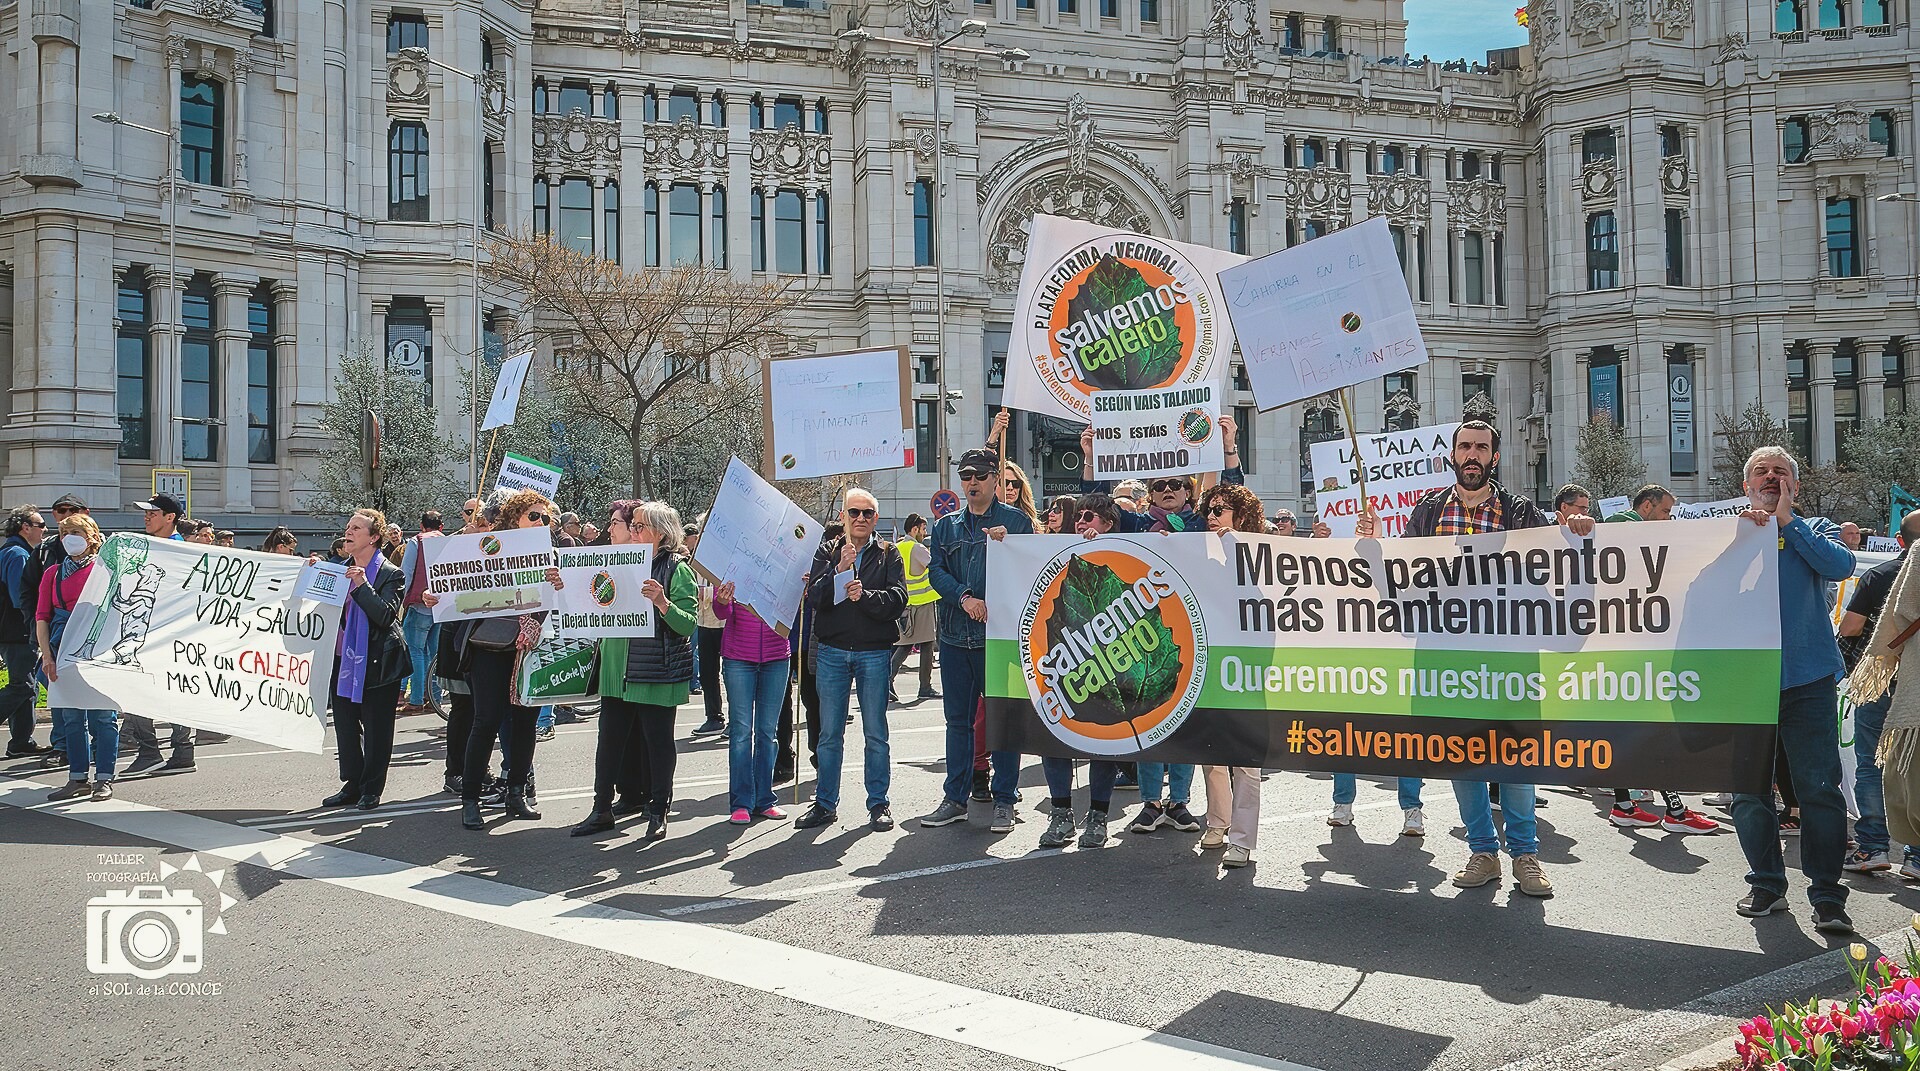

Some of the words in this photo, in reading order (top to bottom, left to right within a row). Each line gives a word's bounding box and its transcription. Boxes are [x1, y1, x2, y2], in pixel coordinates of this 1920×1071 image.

[1035, 246, 1101, 329] PLATAFORMA
[1231, 274, 1300, 308] ZAHORRA
[1316, 264, 1333, 278] EN
[1348, 254, 1366, 269] EL
[1055, 280, 1191, 352] salvemos
[1052, 347, 1086, 383] el
[1079, 315, 1167, 372] calero
[1095, 393, 1132, 412] SEGÚN
[1134, 394, 1160, 411] VAIS
[1162, 387, 1211, 408] TALANDO
[1096, 427, 1121, 440] NOS
[1130, 424, 1168, 439] ESTÁIS
[1371, 436, 1424, 458] TALA
[1432, 433, 1448, 451] A
[1098, 449, 1189, 472] MATANDO
[429, 560, 482, 579] ¡SABEMOS
[485, 557, 505, 572] QUE
[507, 553, 550, 571] MIENTEN
[430, 579, 449, 594] LOS
[450, 575, 492, 592] PARQUES
[493, 573, 514, 588] SON
[514, 569, 548, 586] VERDE
[560, 553, 576, 569] ¡Más
[577, 552, 603, 567] árboles
[604, 554, 609, 567] y
[609, 550, 645, 566] arbustos!
[1235, 542, 1373, 589] Menos
[1384, 538, 1627, 599] pavimento
[1640, 545, 1669, 593] y
[196, 594, 241, 628] VIDA
[240, 620, 250, 639] y
[256, 607, 325, 640] SALUD
[562, 613, 588, 629] ¡Dejad
[589, 612, 600, 628] de
[601, 611, 615, 627] dar
[617, 611, 648, 627] sustos!
[1025, 597, 1041, 681] PLATAFORMA
[1034, 558, 1068, 600] VECINAL
[1037, 566, 1176, 688] salvemos
[1239, 587, 1324, 632] más
[1337, 588, 1671, 636] mantenimiento
[173, 640, 207, 667] POR
[214, 655, 234, 671] UN
[239, 650, 310, 686] CALERO
[1063, 618, 1160, 704] calero
[1147, 594, 1207, 743] salvemoselcalero@gmail.com
[1220, 655, 1388, 696] Queremos
[1398, 664, 1546, 701] nuestros
[1558, 661, 1701, 702] árboles
[167, 671, 200, 695] MAS
[205, 671, 241, 701] VIVO
[240, 693, 253, 711] y
[1036, 680, 1076, 725] el
[1286, 720, 1613, 770] #salvemoselcalero
